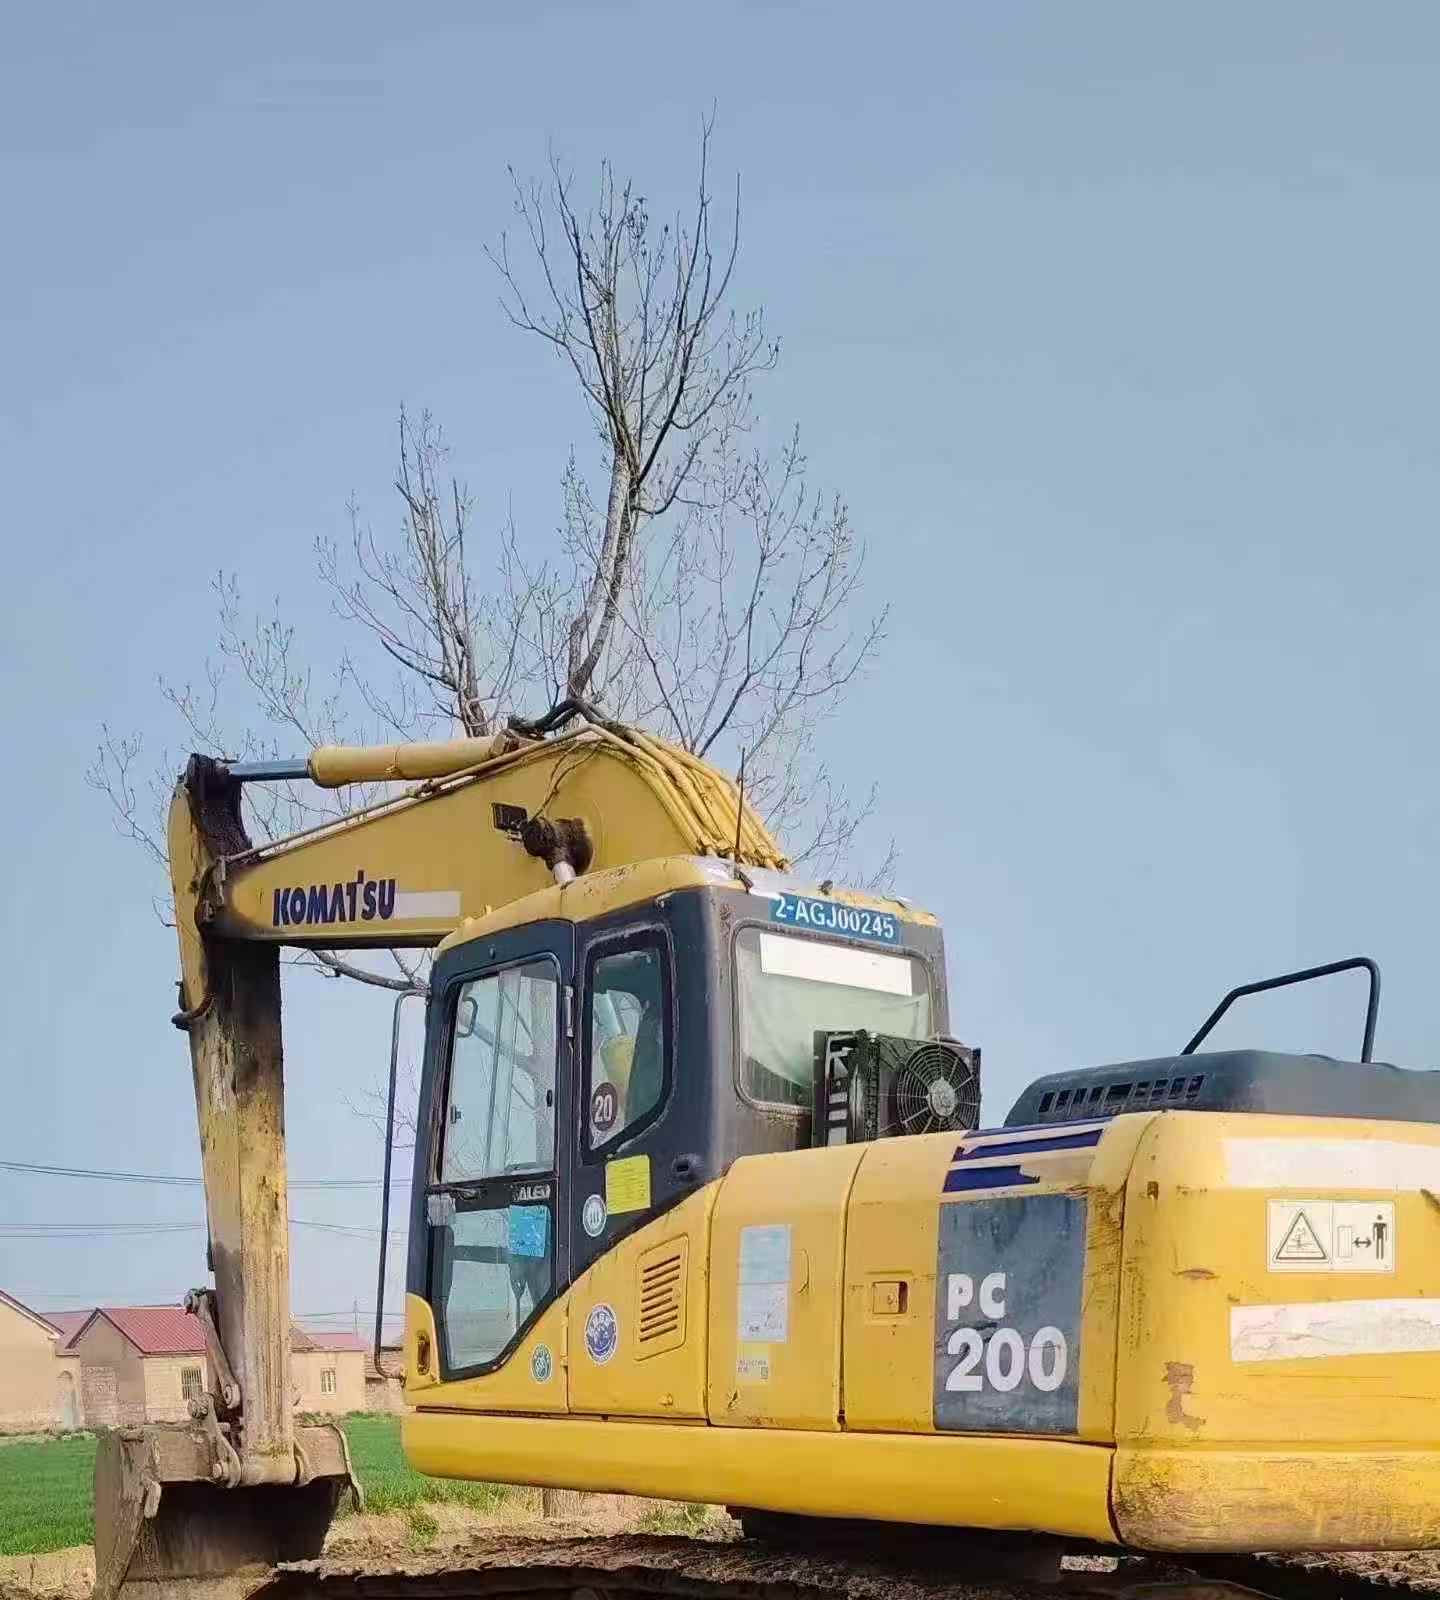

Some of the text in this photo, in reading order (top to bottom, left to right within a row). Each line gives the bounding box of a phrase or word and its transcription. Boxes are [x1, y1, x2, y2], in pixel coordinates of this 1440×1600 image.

[273, 870, 396, 926] KOMATSU
[775, 896, 894, 938] 2-AGJ00245
[594, 1094, 612, 1122] 20
[947, 1272, 1006, 1320] PC
[945, 1326, 1067, 1392] 200
